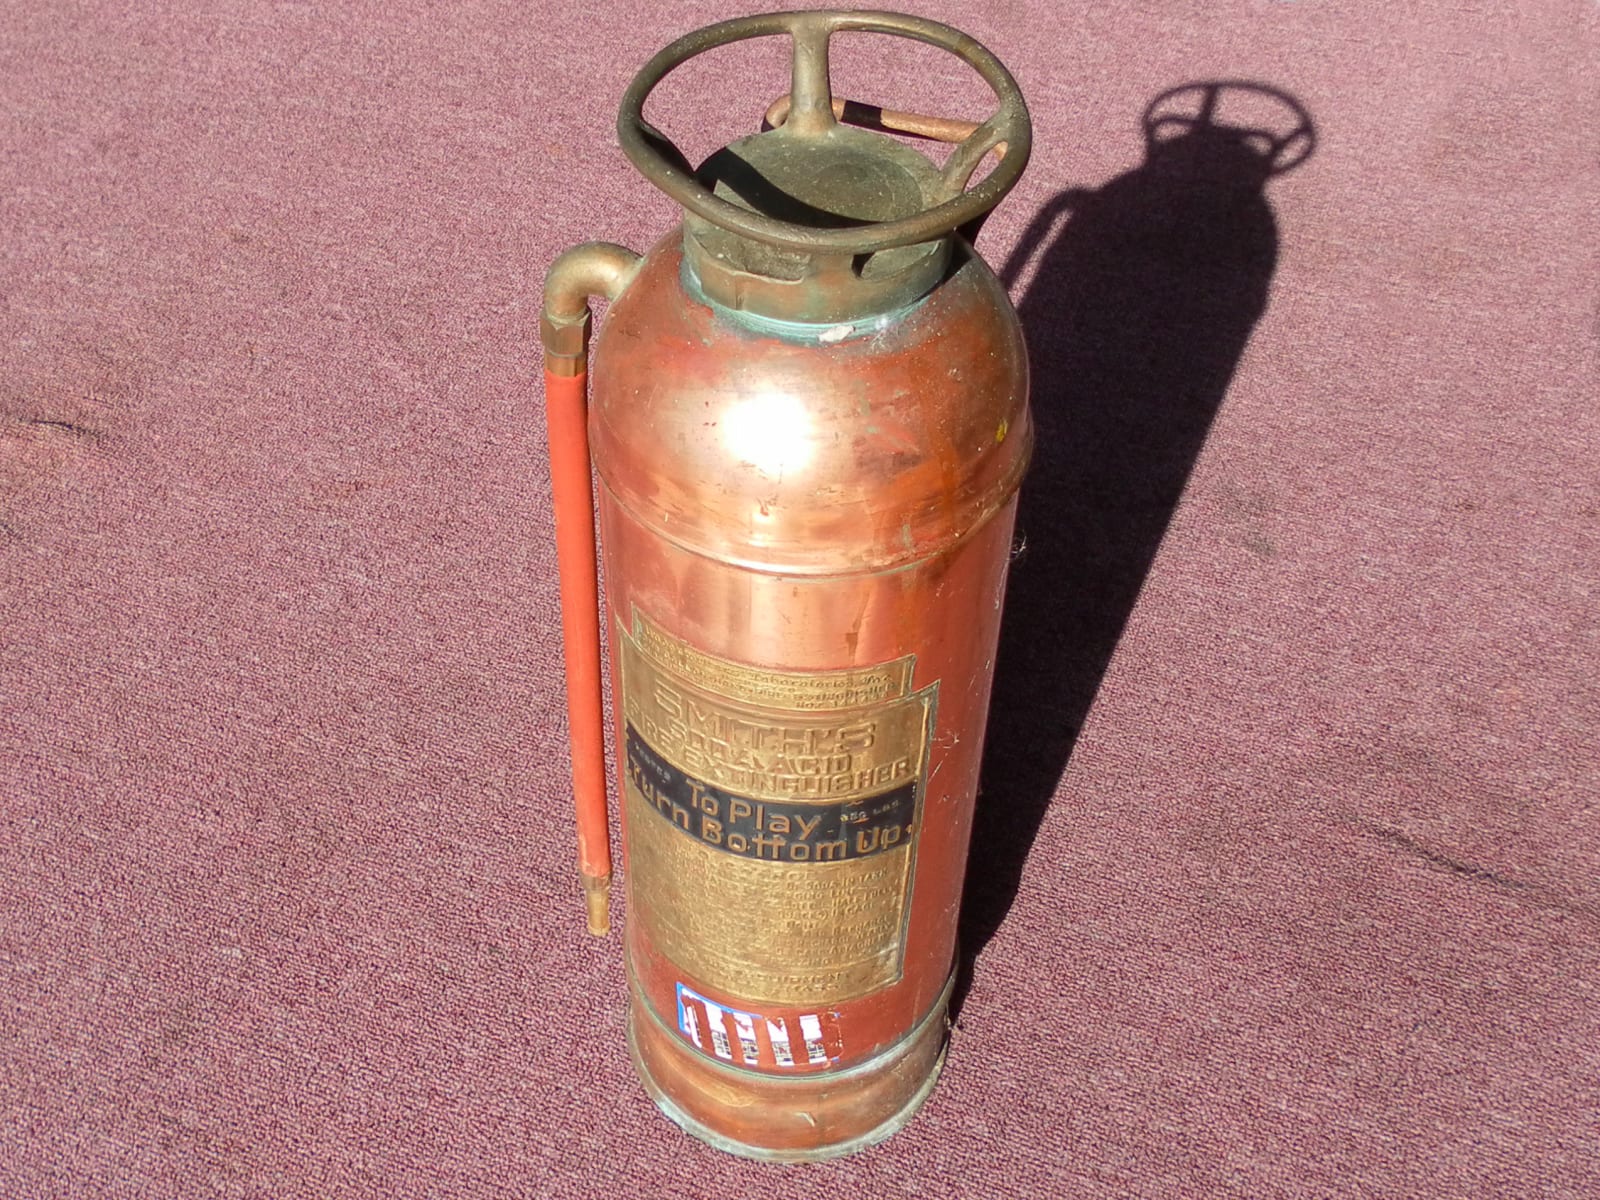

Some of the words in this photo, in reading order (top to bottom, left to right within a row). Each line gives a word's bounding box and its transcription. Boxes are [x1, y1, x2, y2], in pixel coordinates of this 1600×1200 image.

[654, 678, 876, 754] SMITH'S
[684, 745, 910, 794] EXTINGUISHER
[629, 753, 689, 830] Turn
[702, 815, 848, 861] Bottom
[856, 824, 901, 854] Up
[686, 778, 719, 816] To
[729, 798, 823, 841] Play
